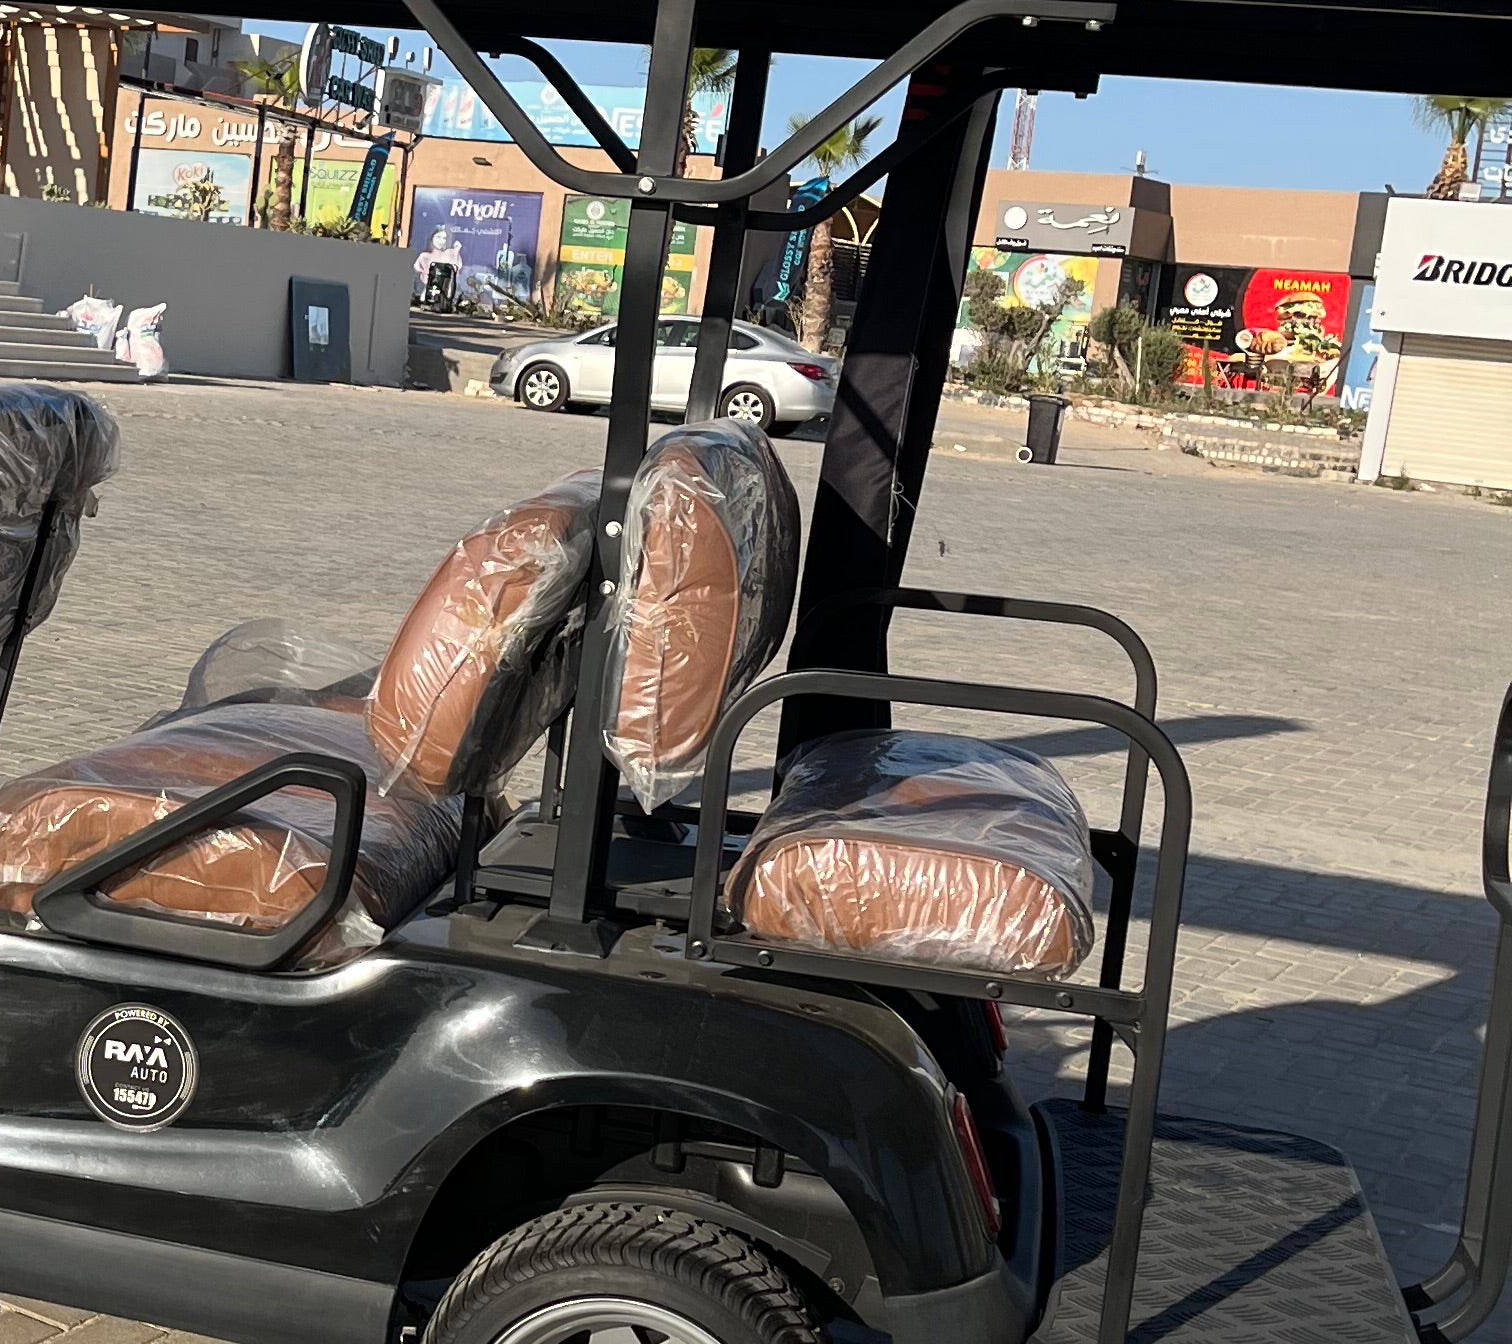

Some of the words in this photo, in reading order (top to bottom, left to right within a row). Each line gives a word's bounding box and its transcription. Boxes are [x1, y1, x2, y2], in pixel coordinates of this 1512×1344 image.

[449, 198, 508, 222] Rivoli
[1274, 279, 1332, 293] NEAMAH
[130, 1066, 168, 1083] AUTO
